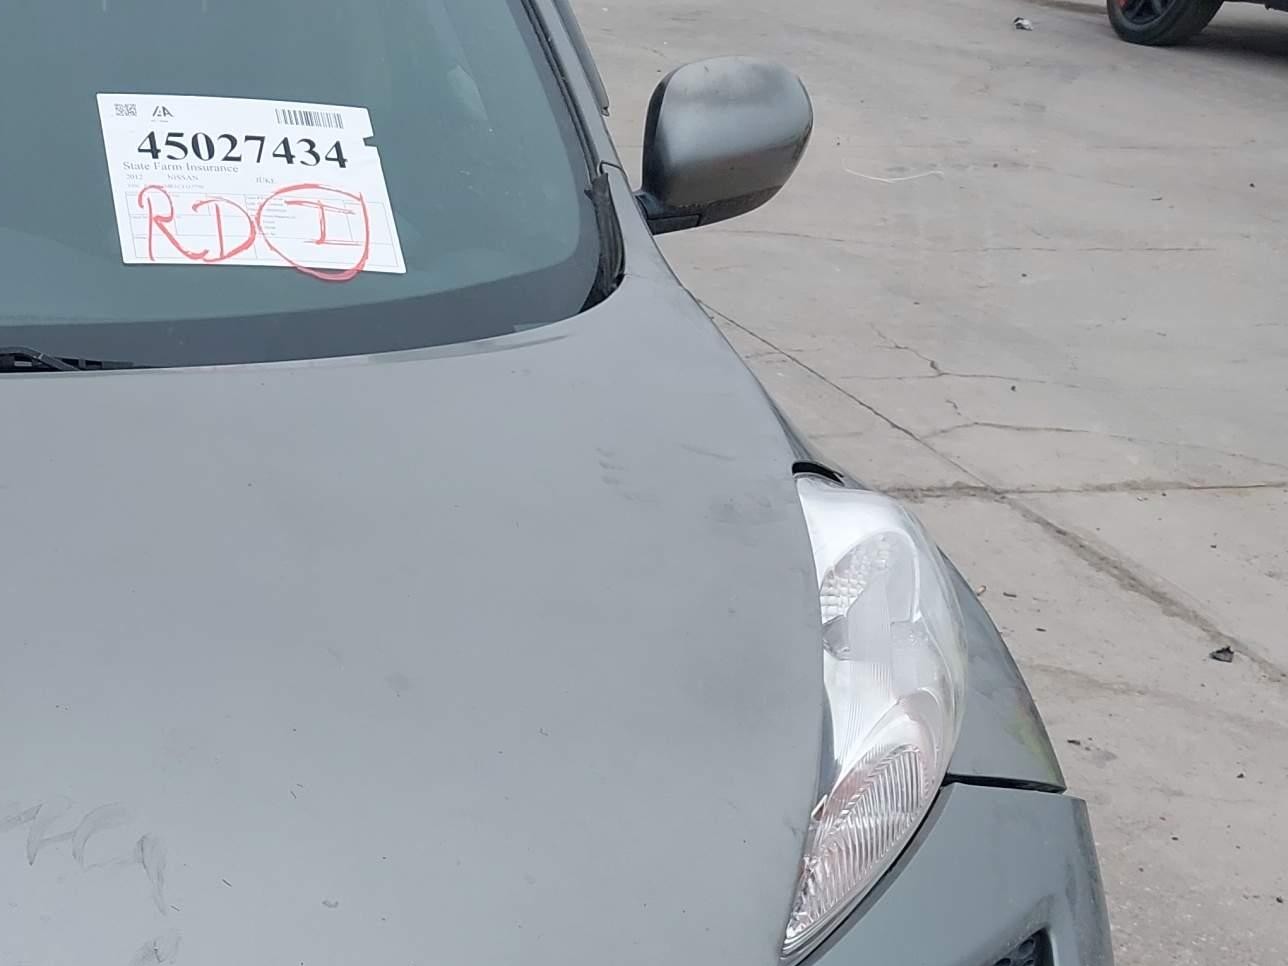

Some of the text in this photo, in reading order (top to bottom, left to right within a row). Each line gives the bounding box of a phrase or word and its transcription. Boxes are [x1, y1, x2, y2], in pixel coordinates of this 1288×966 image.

[137, 130, 348, 169] 45027434
[122, 161, 239, 173] State Farm Insurance
